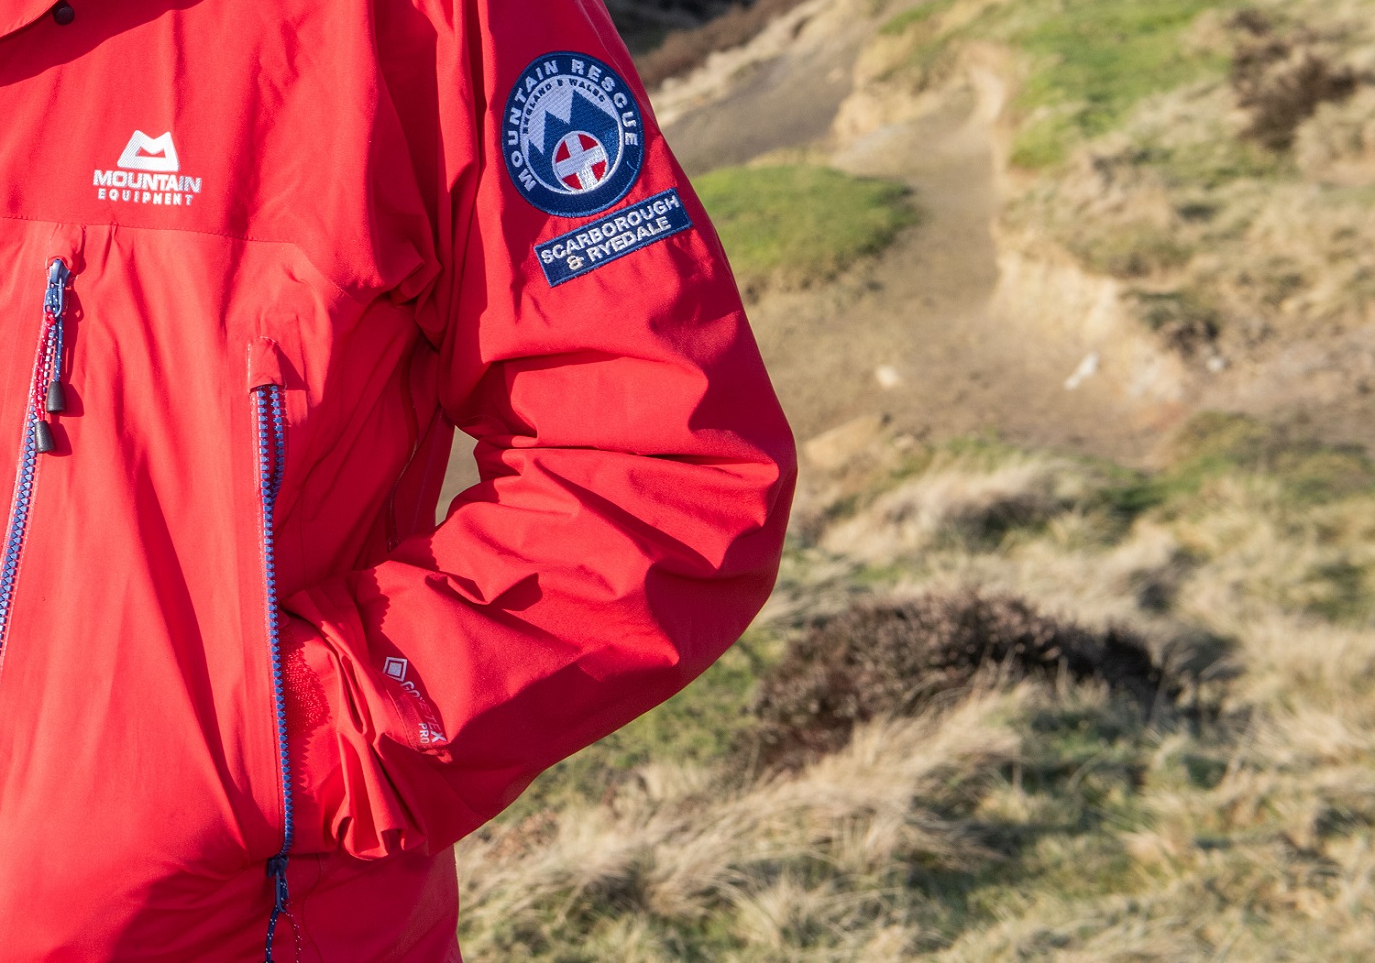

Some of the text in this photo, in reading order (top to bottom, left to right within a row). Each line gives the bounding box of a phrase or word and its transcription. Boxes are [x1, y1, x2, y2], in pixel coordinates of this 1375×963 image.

[507, 58, 639, 192] MOUNTAIN RESCUE
[93, 169, 202, 193] MOUNTAIN
[97, 188, 194, 206] EQUIPMENT
[540, 194, 681, 264] SCARBOROUGH
[566, 216, 672, 271] & RYEDALE
[418, 722, 430, 744] PRO
